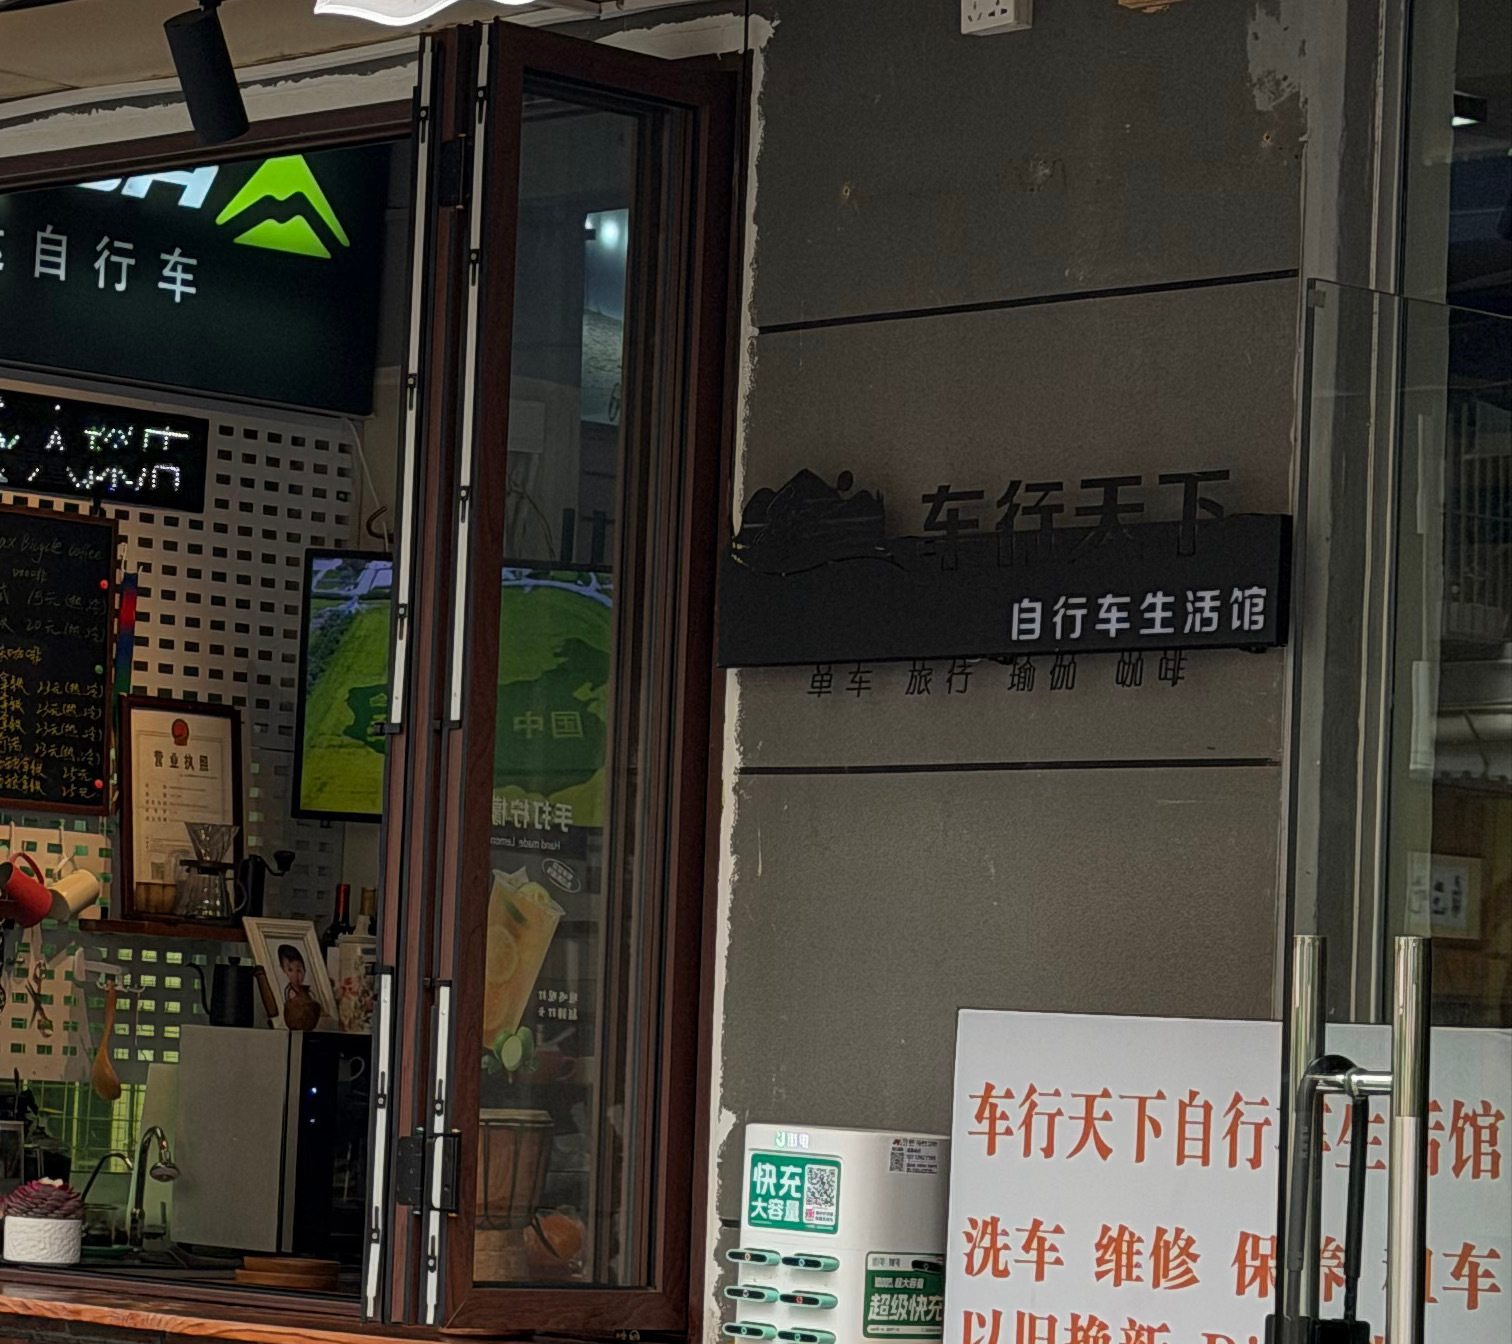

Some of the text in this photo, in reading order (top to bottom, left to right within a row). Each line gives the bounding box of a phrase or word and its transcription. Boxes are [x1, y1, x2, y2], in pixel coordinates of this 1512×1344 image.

[1010, 585, 1269, 642] 自行车生活馆
[806, 660, 874, 699] 单车
[967, 1080, 1506, 1183] 车行天下自行生馆
[752, 1161, 804, 1199] 快充
[750, 1196, 801, 1223] 大容量
[961, 1216, 1067, 1286] 洗车
[1093, 1223, 1202, 1292] 维修
[867, 1293, 944, 1322] 超级快充
